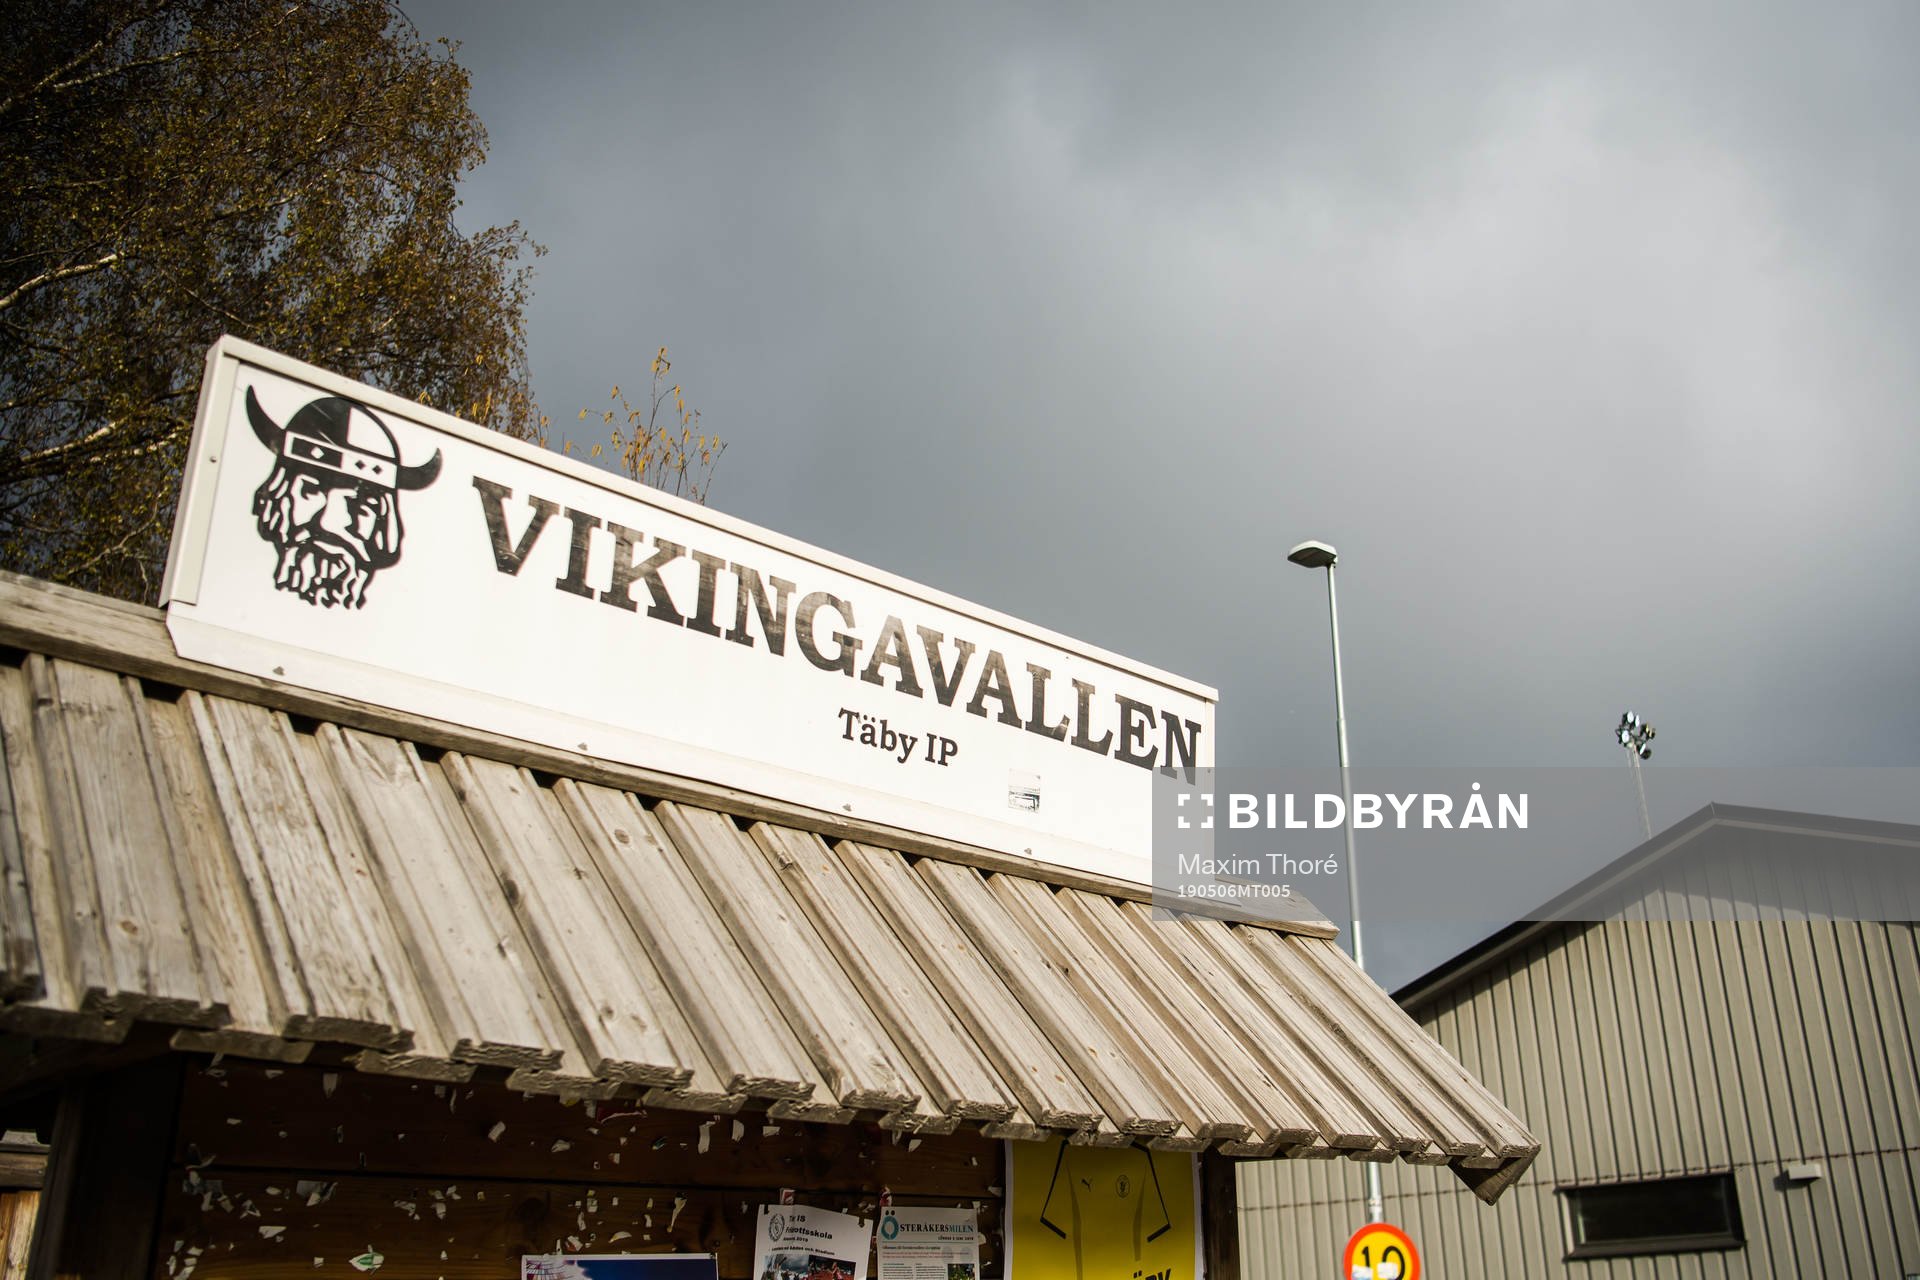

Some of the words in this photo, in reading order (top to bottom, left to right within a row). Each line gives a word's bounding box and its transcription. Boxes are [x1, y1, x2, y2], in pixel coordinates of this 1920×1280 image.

[472, 475, 1201, 786] VIKINGAVALLEN
[838, 707, 918, 764] Täby
[925, 733, 958, 766] IP
[881, 1209, 974, 1240] ÖSTERÅKERSMILEN
